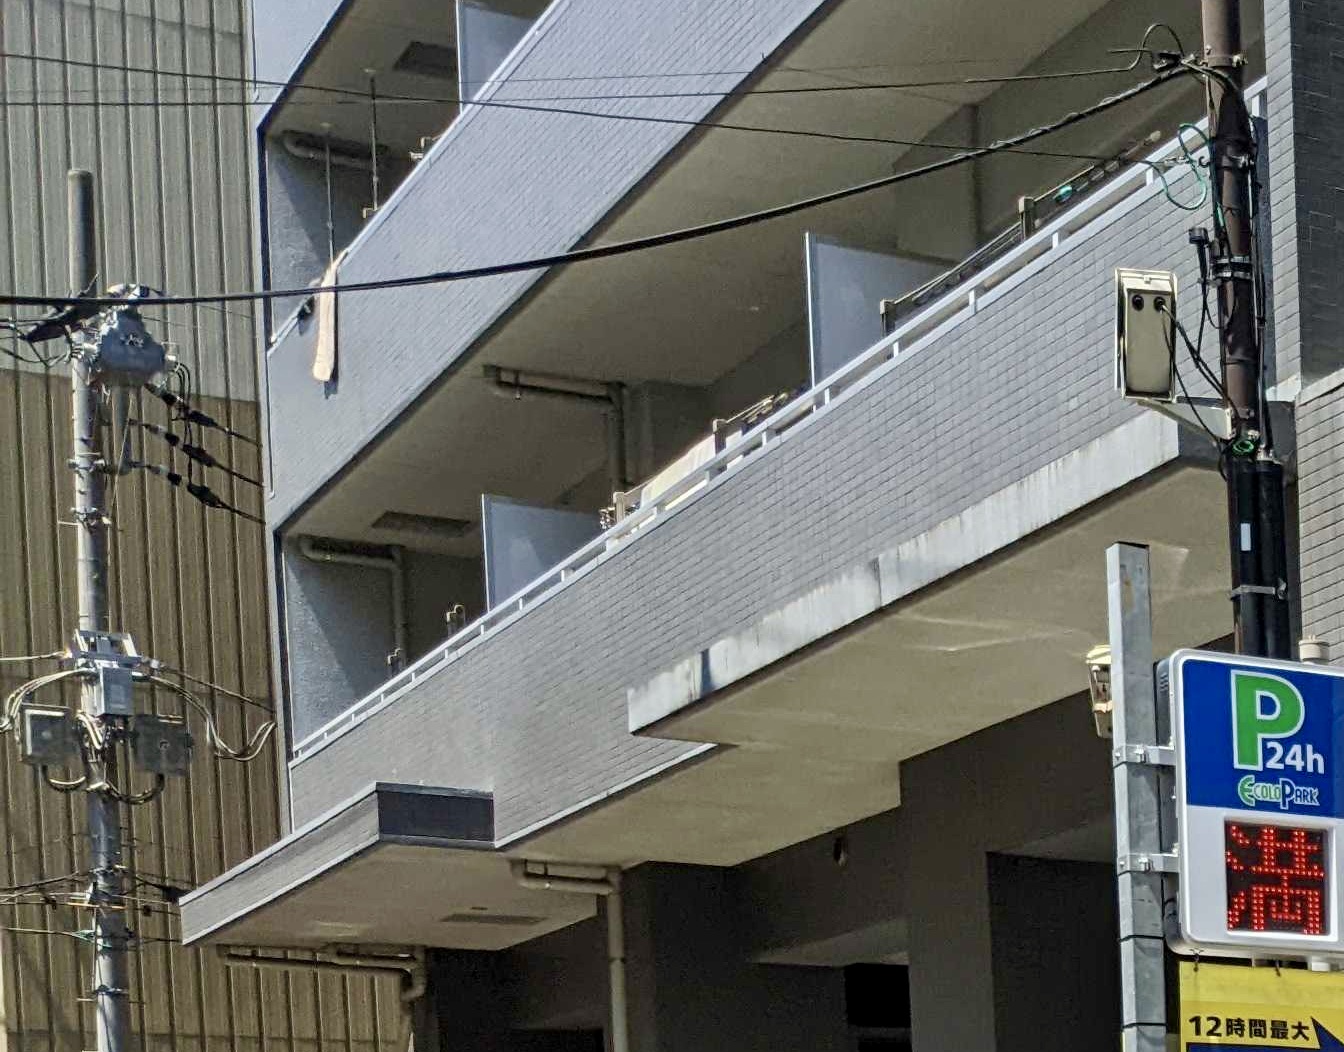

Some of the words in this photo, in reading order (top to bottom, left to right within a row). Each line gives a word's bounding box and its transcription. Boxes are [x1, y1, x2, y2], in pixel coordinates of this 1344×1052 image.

[1231, 669, 1305, 771] P
[1266, 741, 1325, 774] 24h
[1226, 825, 1325, 935] 満
[1189, 1015, 1310, 1041] 12時間最大
